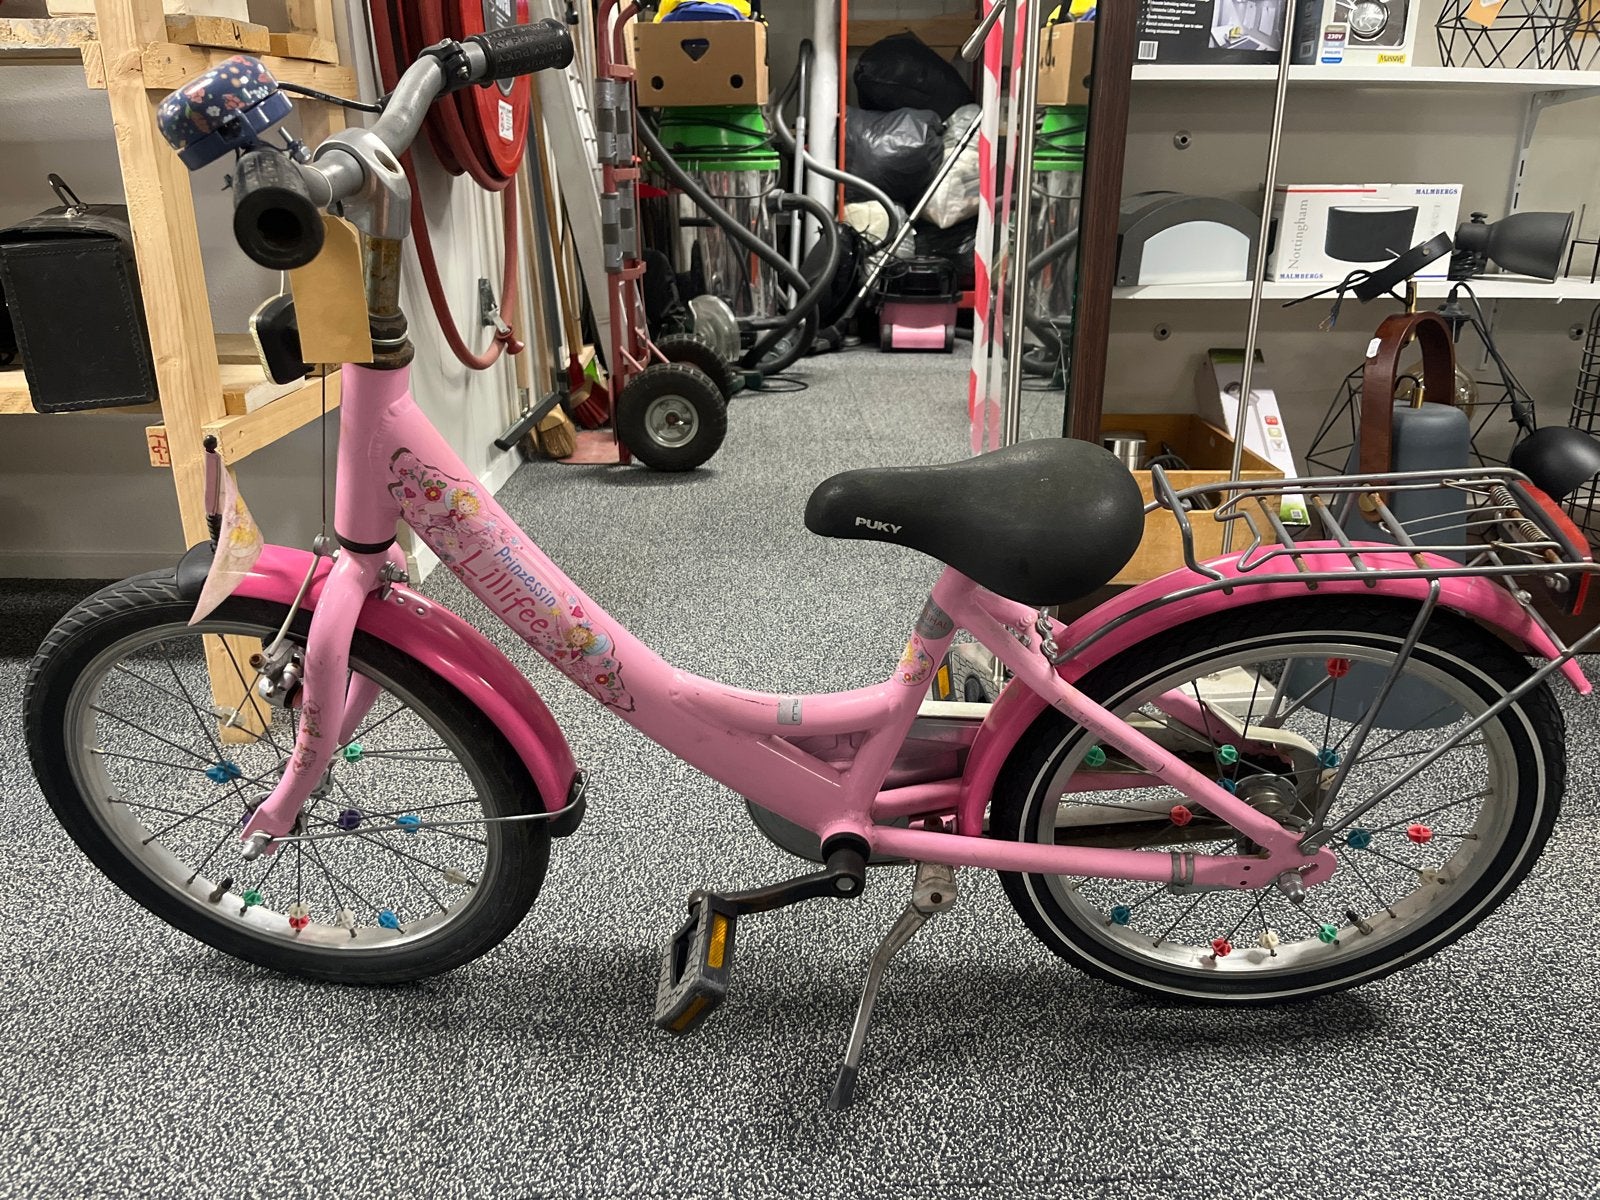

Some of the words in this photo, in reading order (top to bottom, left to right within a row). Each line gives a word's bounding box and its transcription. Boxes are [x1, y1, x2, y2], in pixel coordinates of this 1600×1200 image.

[1288, 199, 1309, 270] Nottingham
[855, 516, 902, 534] PUKY
[460, 549, 549, 634] Lillifee
[494, 546, 557, 608] Prinzessin
